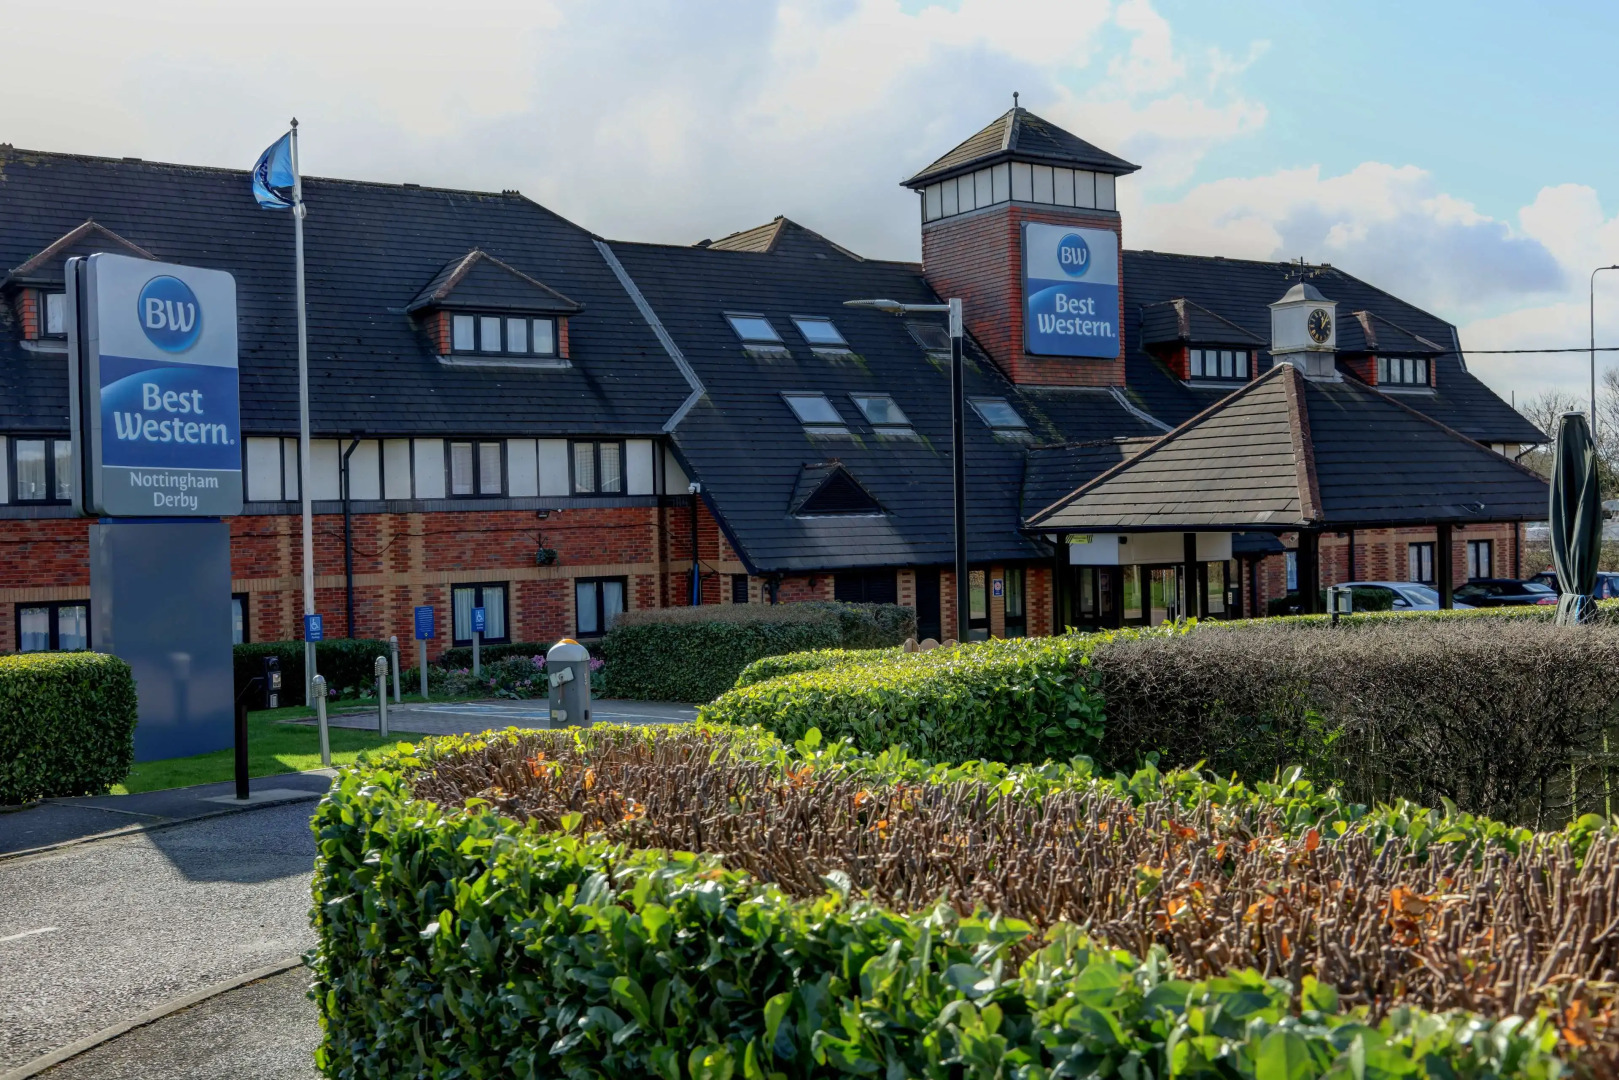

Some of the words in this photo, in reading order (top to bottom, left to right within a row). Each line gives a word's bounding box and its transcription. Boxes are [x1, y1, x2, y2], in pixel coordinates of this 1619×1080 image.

[1061, 246, 1087, 265] BW
[1055, 293, 1095, 315] Best
[145, 297, 196, 333] BW
[142, 382, 204, 415] Best
[130, 471, 219, 491] Nottingham
[153, 491, 198, 511] Derby
